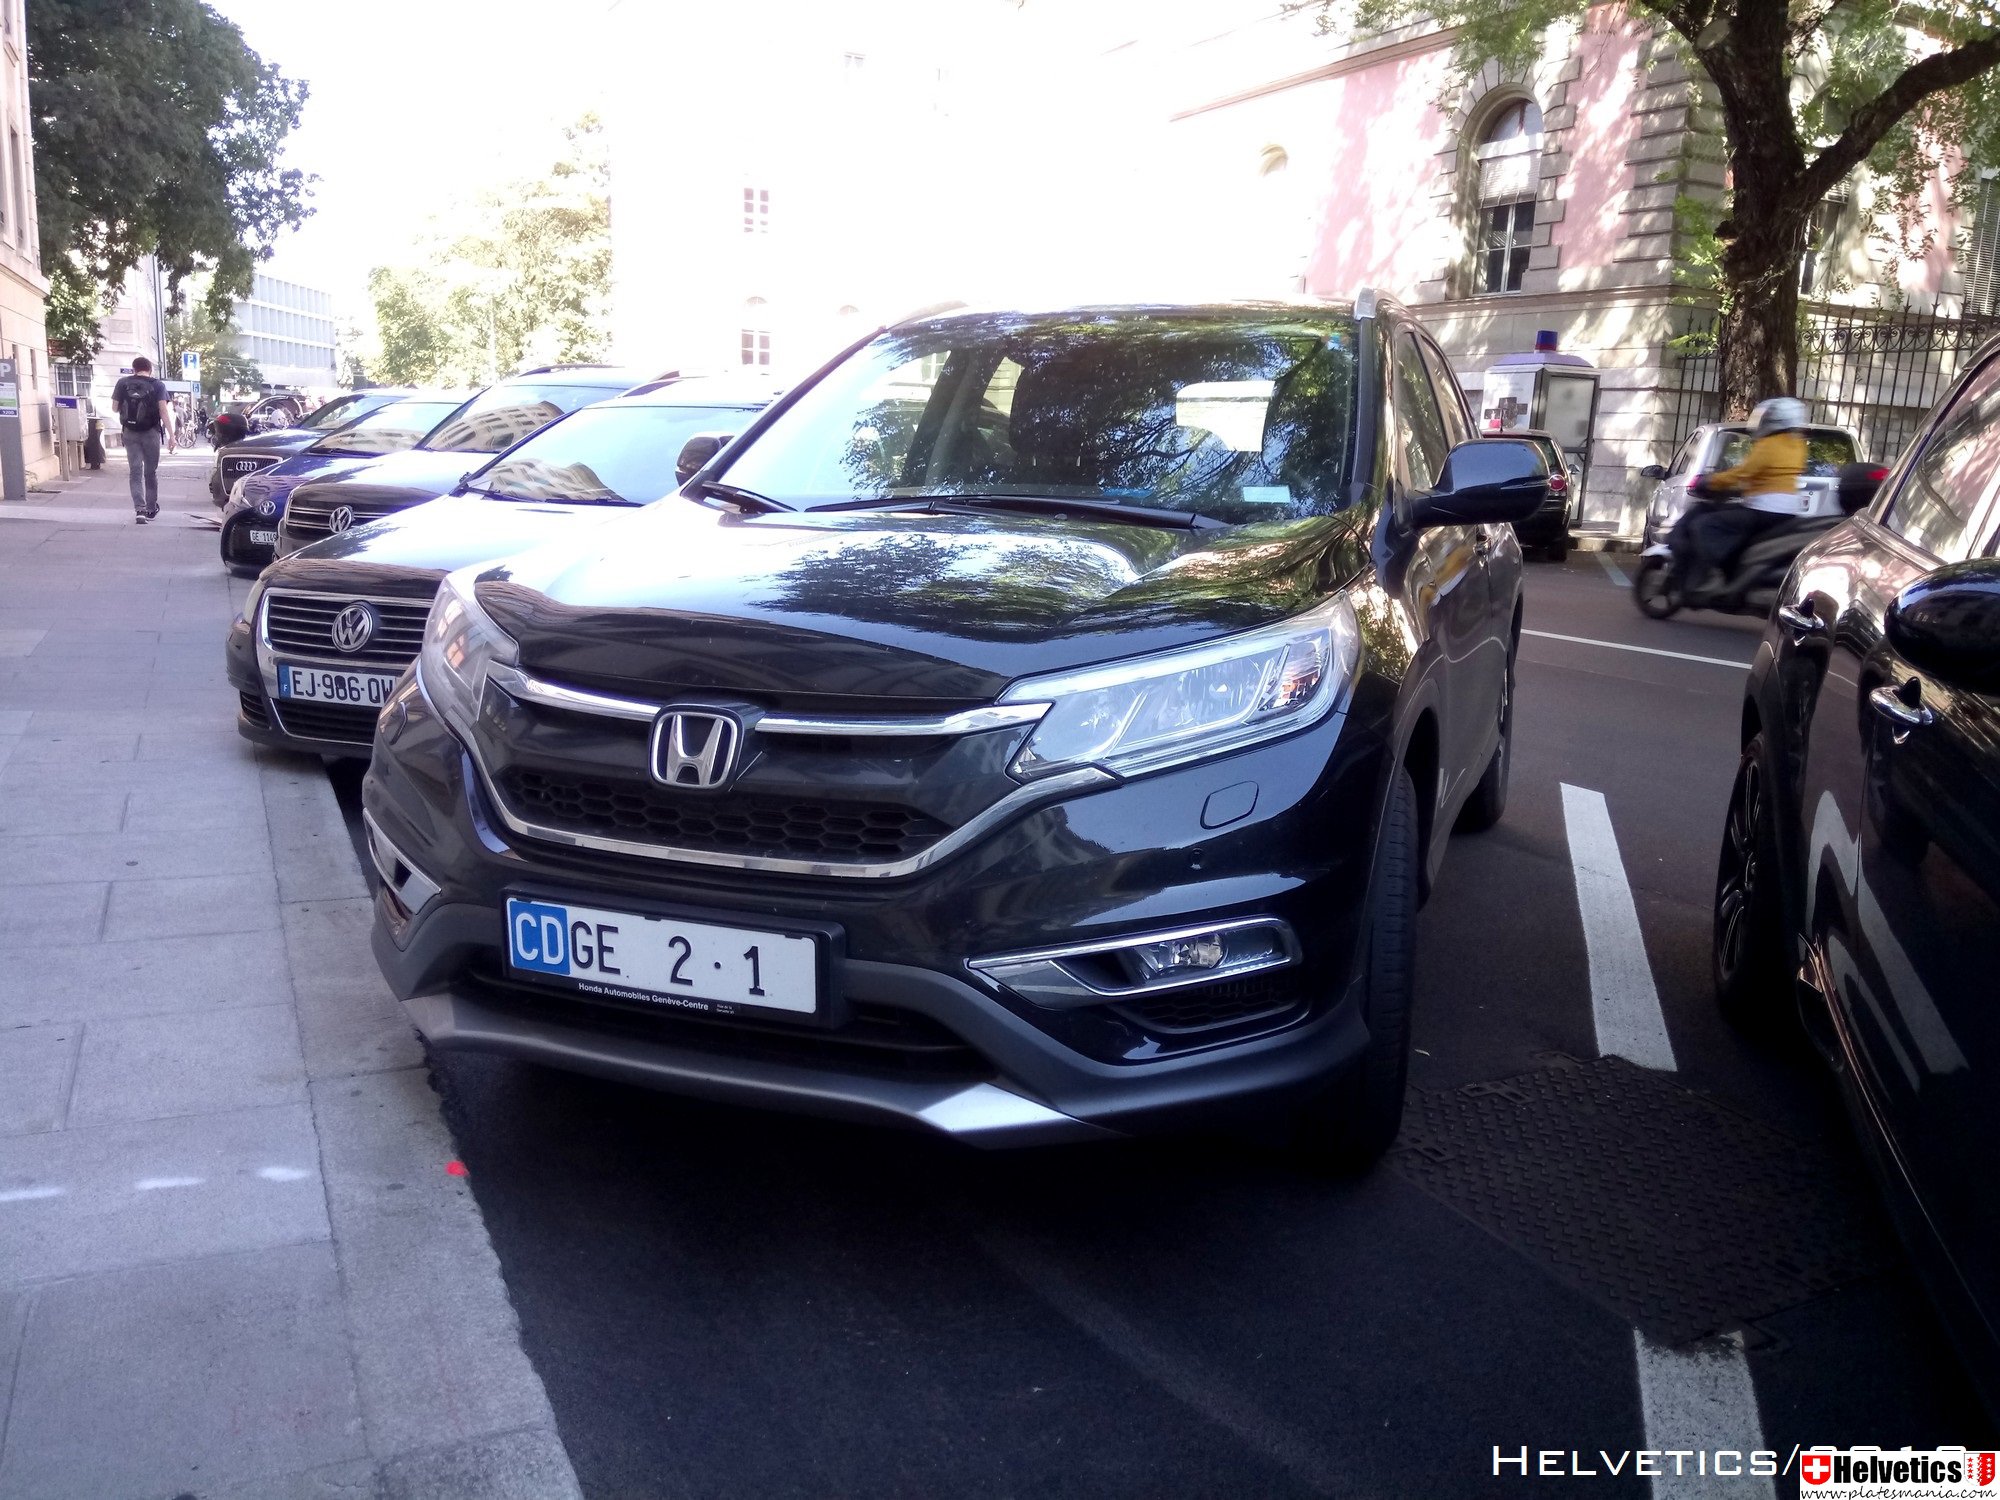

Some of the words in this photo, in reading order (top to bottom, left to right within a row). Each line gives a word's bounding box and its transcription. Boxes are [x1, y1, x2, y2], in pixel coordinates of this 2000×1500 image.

[0, 362, 11, 377] P
[251, 532, 260, 540] GE
[515, 912, 565, 965] CD
[570, 921, 621, 975] GE
[578, 982, 603, 994] Honda
[603, 987, 651, 1002] Automobiles
[651, 994, 709, 1011] Genève-Centre
